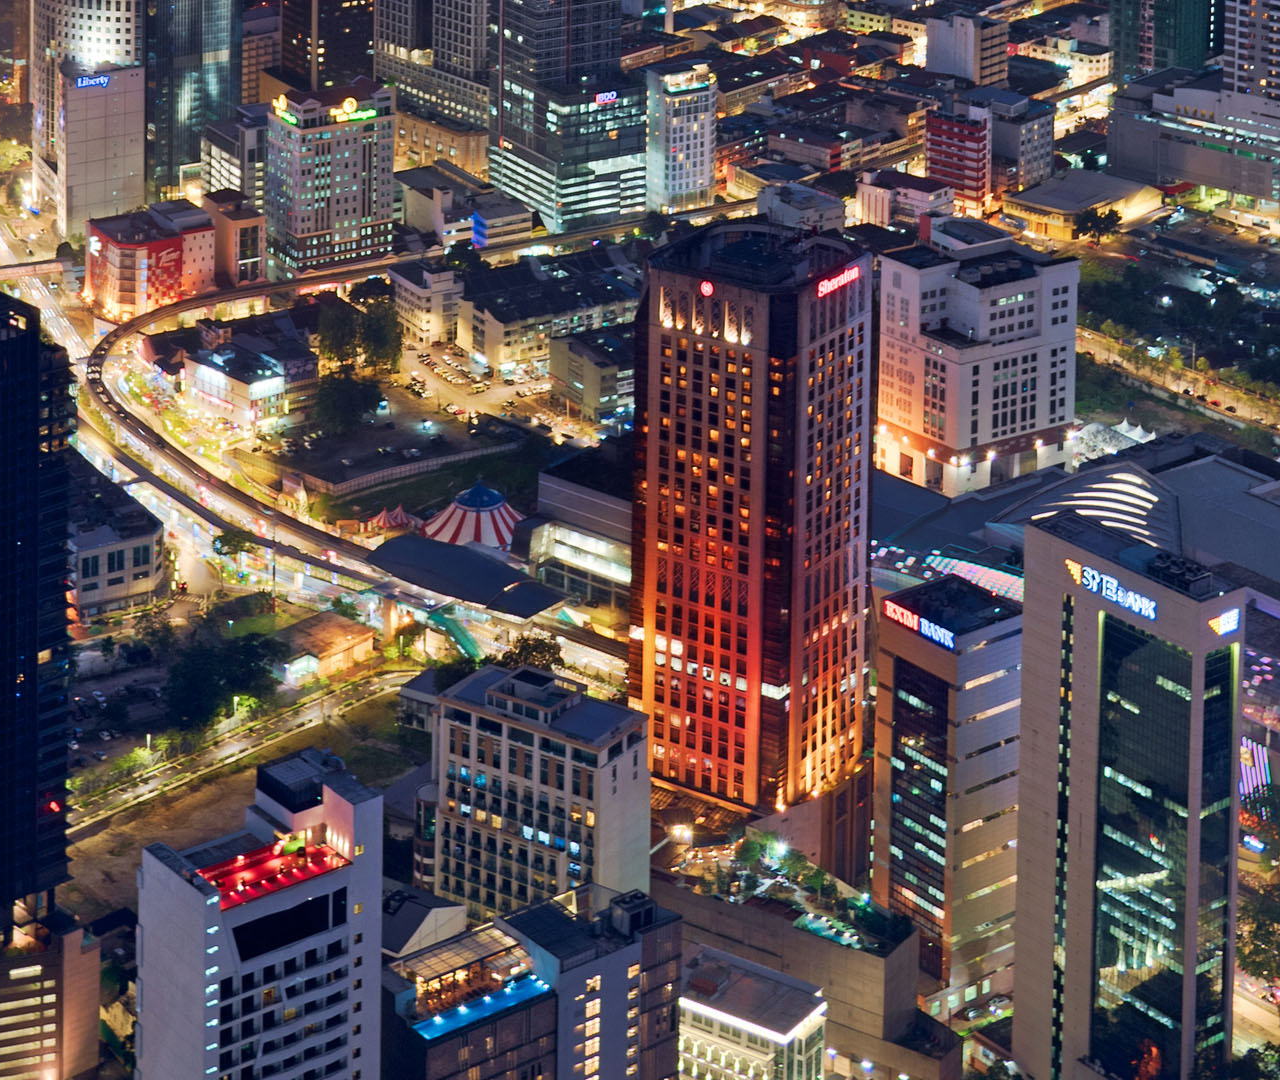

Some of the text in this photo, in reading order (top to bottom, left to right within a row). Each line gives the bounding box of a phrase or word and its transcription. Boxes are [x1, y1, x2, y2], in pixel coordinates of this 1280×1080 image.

[76, 75, 110, 88] Liberty
[598, 91, 617, 102] BDO
[817, 265, 860, 298] Sheraton
[1117, 586, 1157, 620] BANK
[884, 600, 955, 649] EXIM BANK
